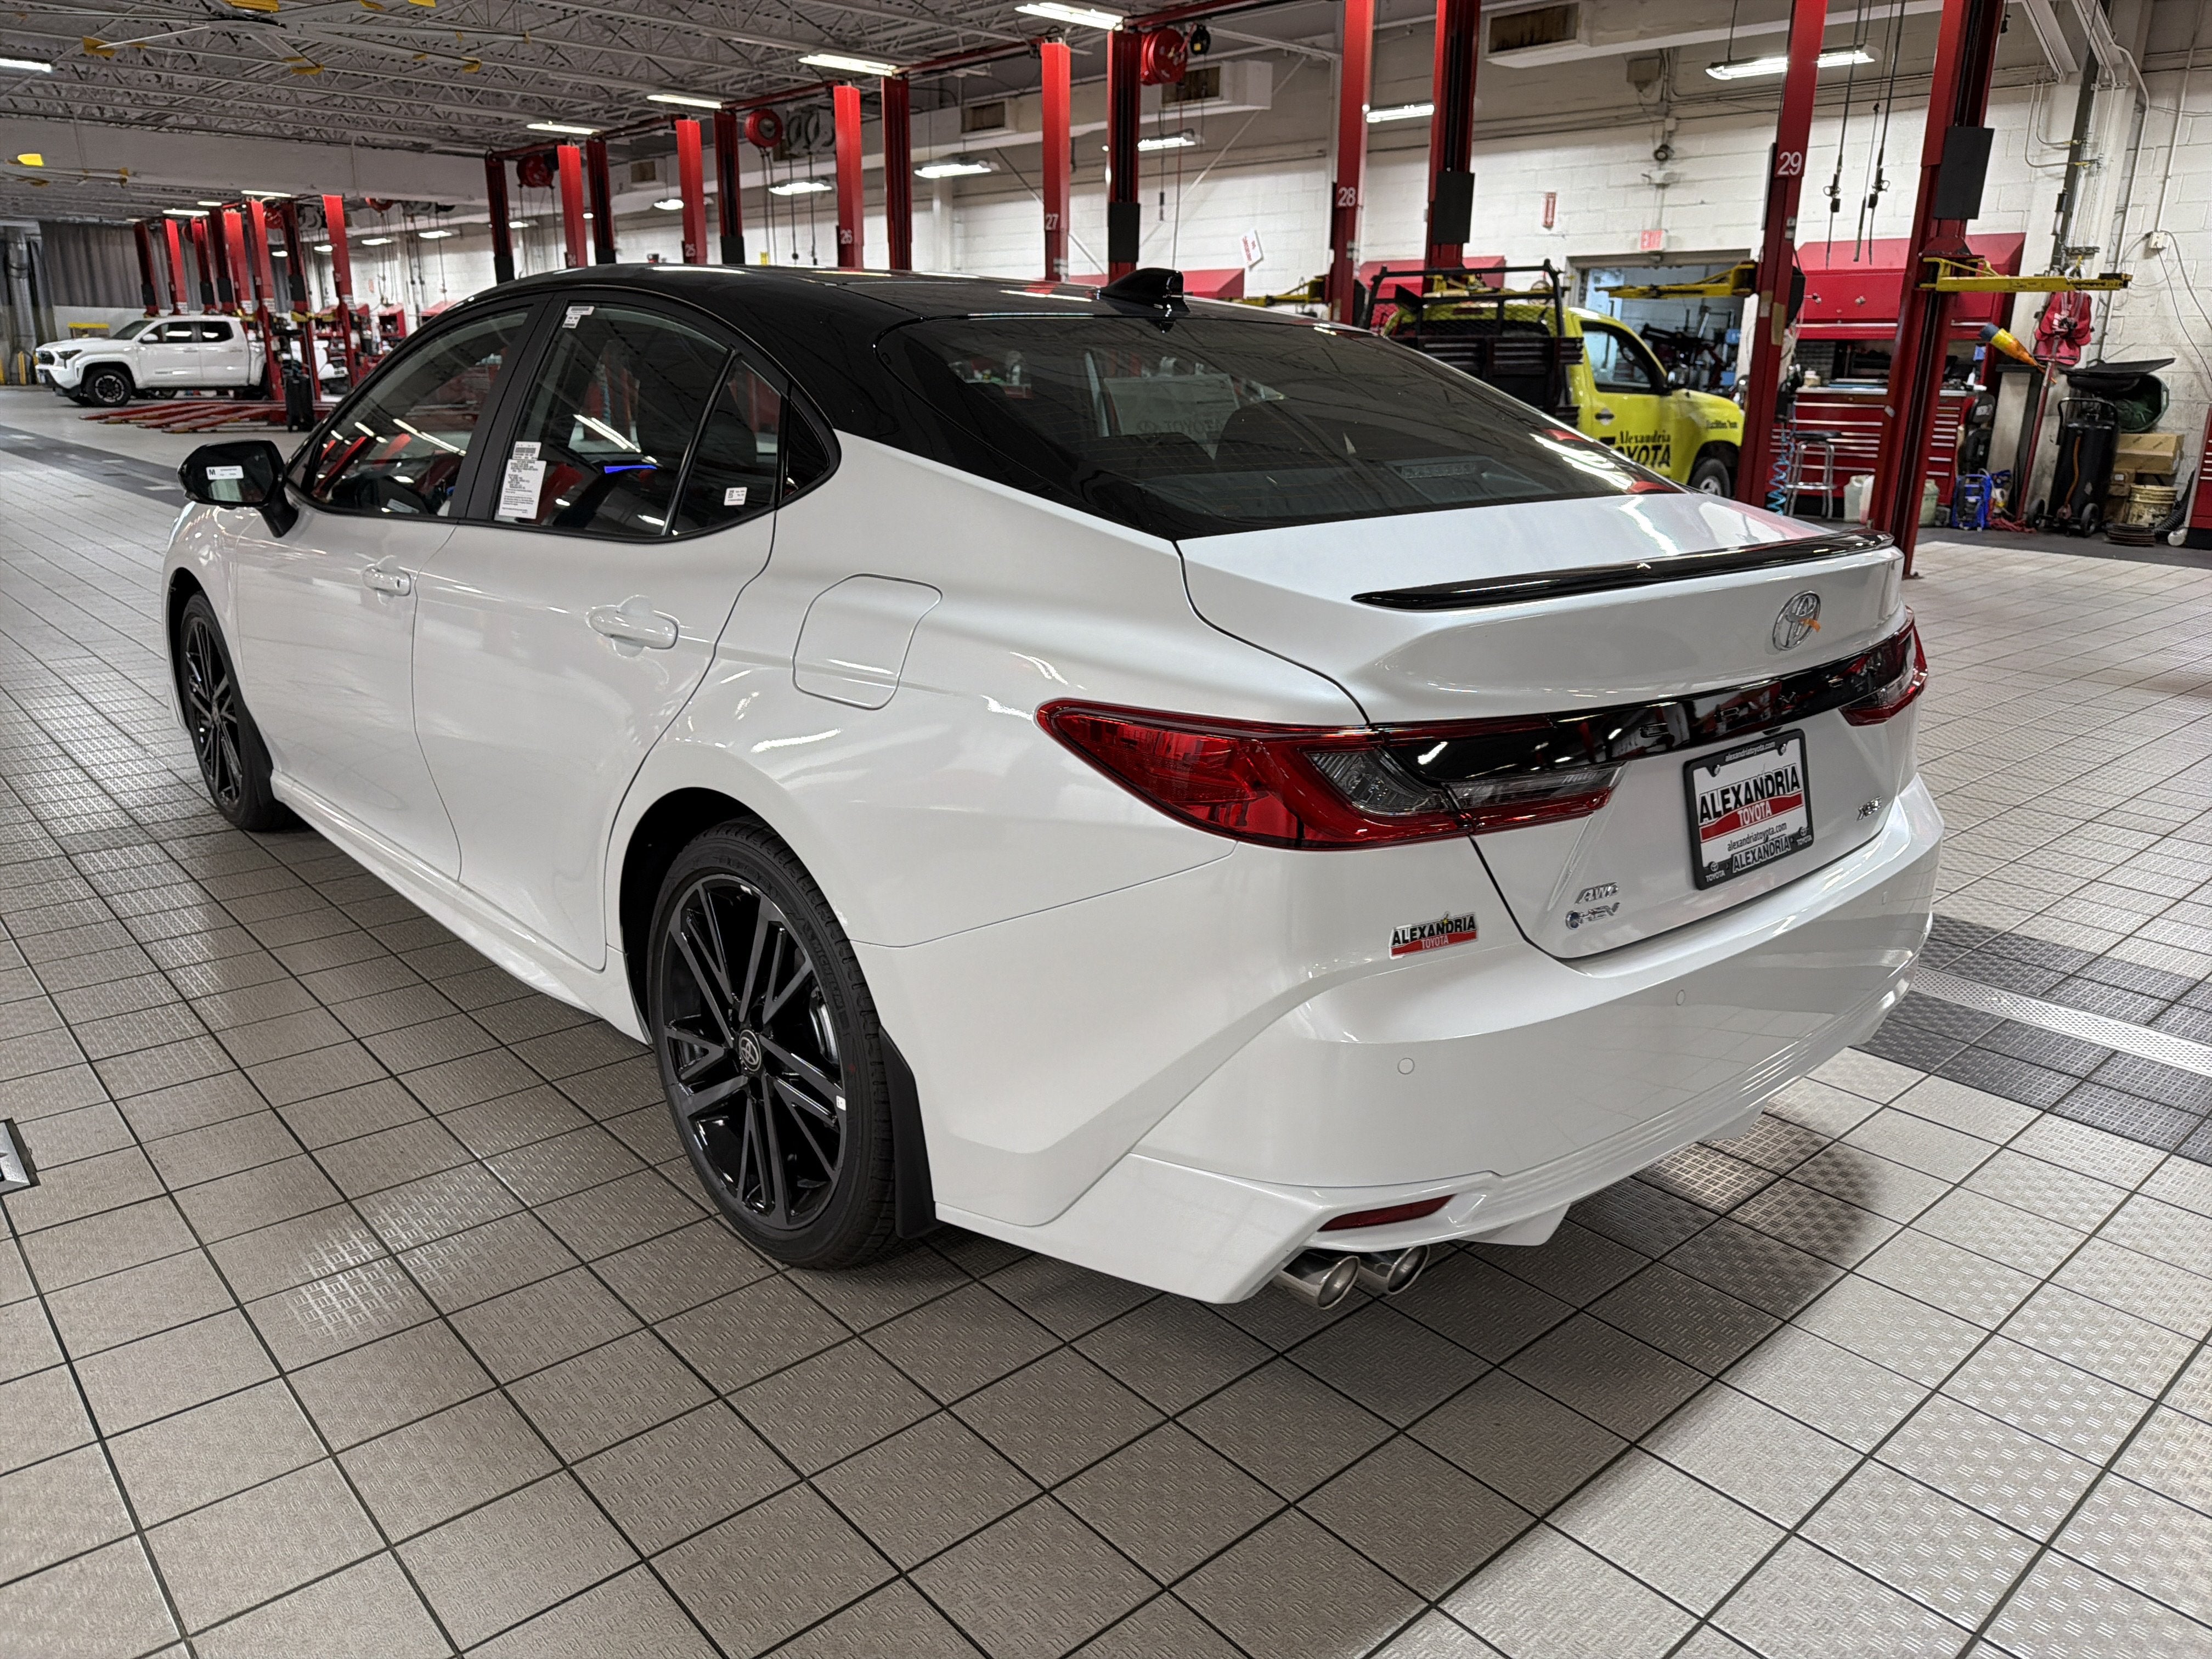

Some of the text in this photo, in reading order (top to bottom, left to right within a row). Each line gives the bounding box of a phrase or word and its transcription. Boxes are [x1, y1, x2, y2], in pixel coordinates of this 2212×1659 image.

[1777, 151, 1803, 176] 29
[1338, 187, 1356, 207] 28
[1046, 213, 1059, 230] 27
[840, 228, 853, 245] 26
[1725, 742, 1776, 762] alexandriatoyota.com
[1700, 765, 1801, 822] ALEXANDRIA
[1737, 800, 1773, 827] TOYOTA
[1727, 822, 1787, 852] alexandriatoyota.com
[1796, 834, 1813, 846] TOYOTA
[1732, 836, 1792, 873] ALEXANDRIA
[1706, 870, 1726, 883] TOYOTA
[1575, 882, 1619, 905] AWD
[1391, 915, 1476, 946] ALEXANDRIA
[1420, 935, 1449, 949] TOYOTA
